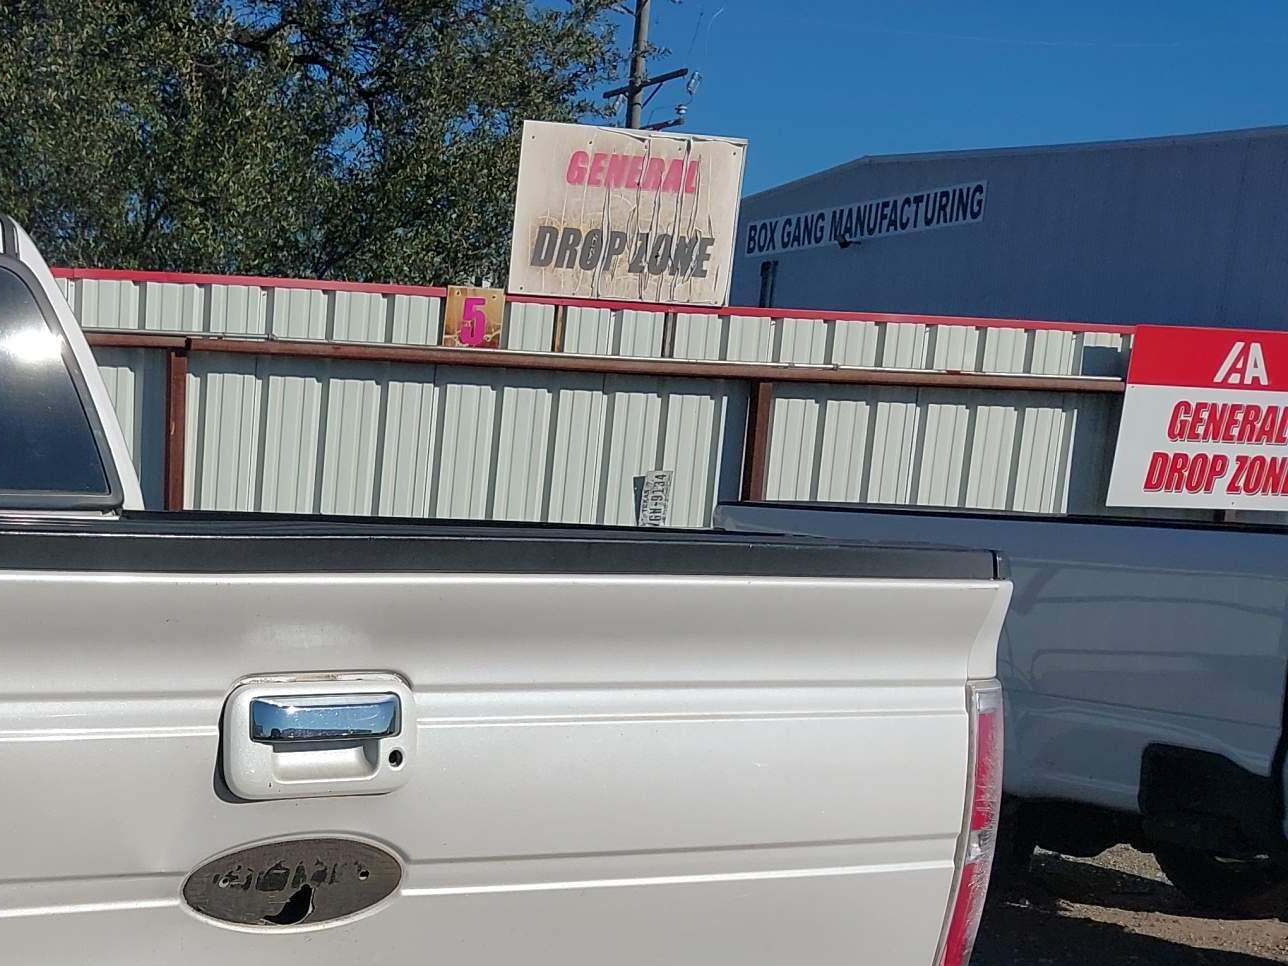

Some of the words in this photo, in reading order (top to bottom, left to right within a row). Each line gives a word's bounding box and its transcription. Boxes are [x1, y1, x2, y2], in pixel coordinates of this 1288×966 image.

[566, 150, 699, 194] GENERAL
[746, 219, 779, 255] BOX
[780, 212, 826, 250] GANG
[828, 184, 984, 243] MANUFACTURING
[529, 224, 628, 272] DROP
[626, 230, 716, 279] ZONE
[458, 297, 487, 346] 5
[1167, 400, 1288, 446] GENERAL
[1143, 451, 1230, 494] DROP
